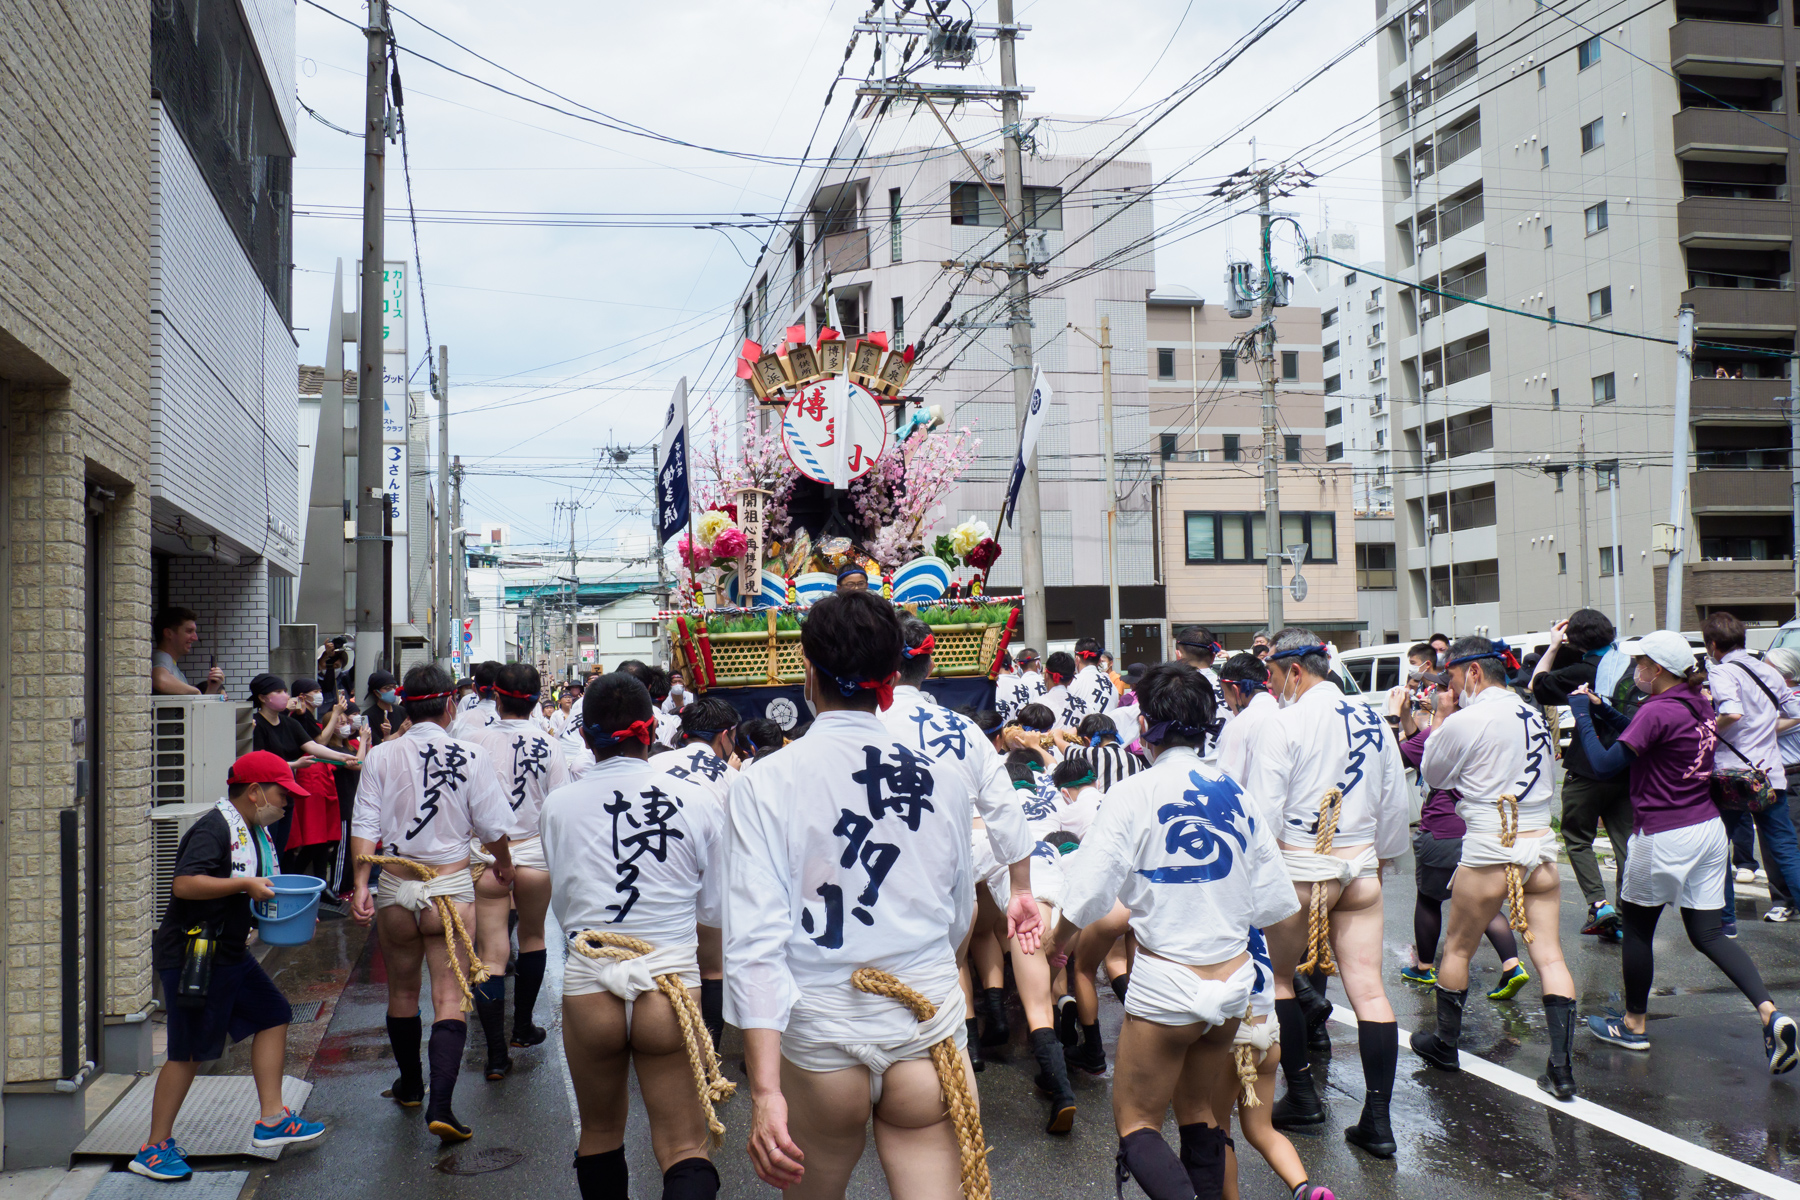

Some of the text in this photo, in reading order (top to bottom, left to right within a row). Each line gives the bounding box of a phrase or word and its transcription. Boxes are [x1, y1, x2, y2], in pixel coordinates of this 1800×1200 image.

[393, 270, 403, 318] カーリース
[763, 361, 781, 385] 大浜
[795, 352, 813, 377] 御供所
[828, 345, 840, 369] 博多
[857, 347, 876, 374] 奈良屋
[886, 358, 906, 383] 冷泉
[388, 464, 401, 518] さんまる
[1091, 674, 1113, 714] 博多
[908, 706, 974, 766] 博
[801, 743, 935, 950] 博多小
